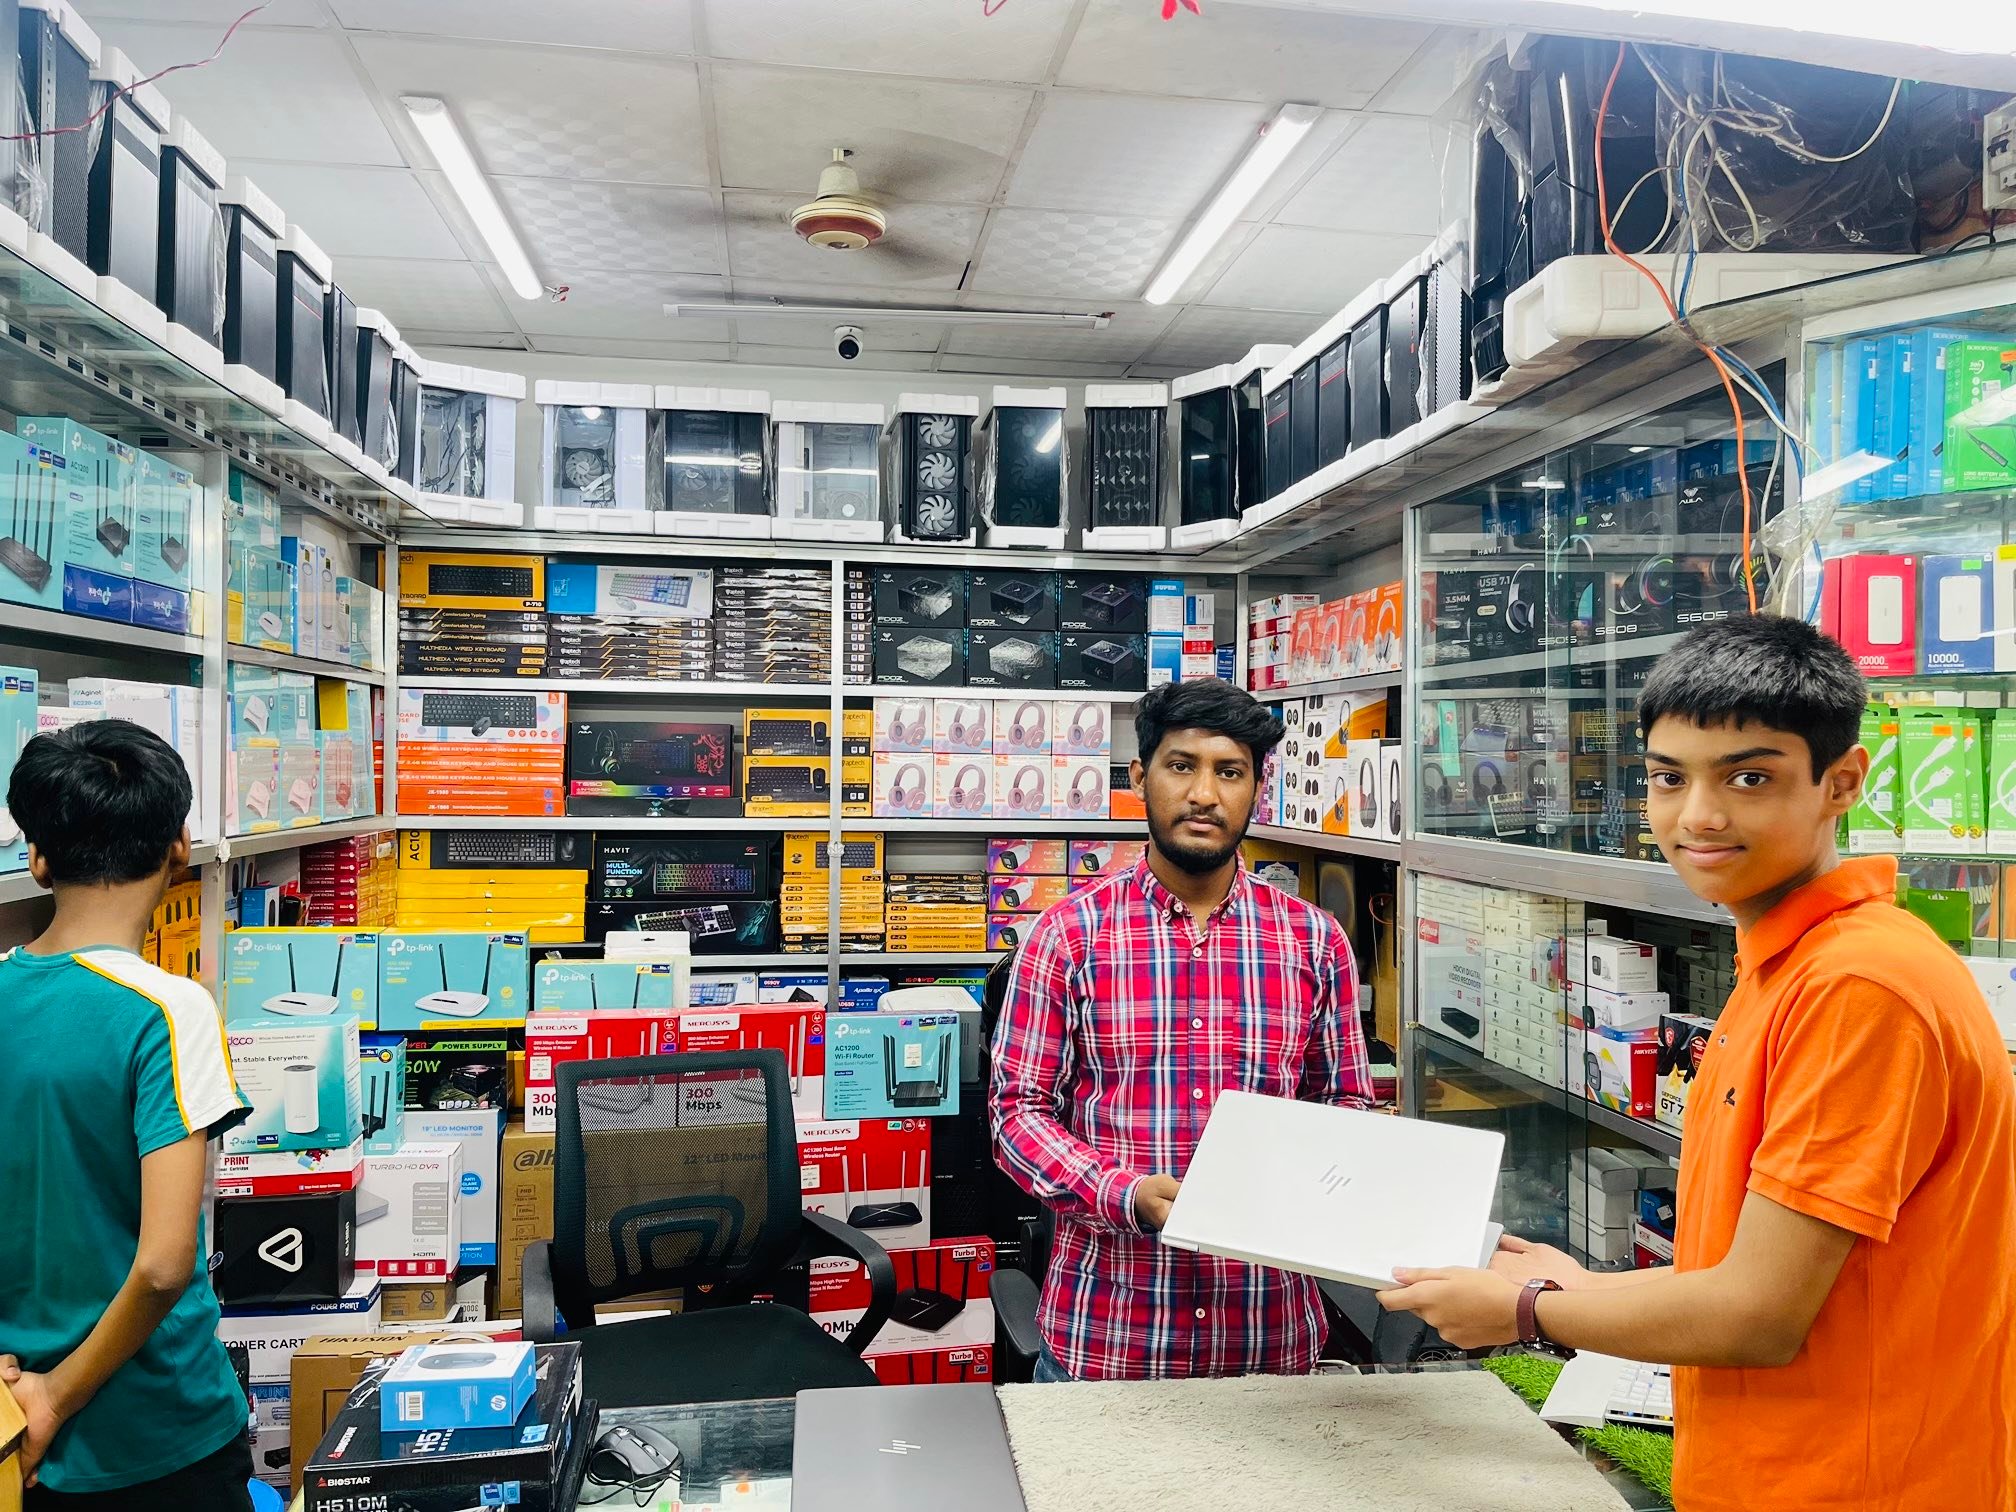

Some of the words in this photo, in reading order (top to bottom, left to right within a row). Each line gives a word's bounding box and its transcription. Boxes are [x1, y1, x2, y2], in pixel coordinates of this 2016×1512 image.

[1478, 546, 1502, 556] HAVIT
[1480, 578, 1498, 588] USB
[1500, 576, 1510, 586] 7.1
[1445, 595, 1470, 604] 3.5MM
[1595, 624, 1638, 636] S608
[1858, 656, 1884, 666] 20000
[1928, 654, 1959, 664] 10000
[254, 943, 282, 952] tp-link
[406, 943, 434, 953] tp-link
[560, 973, 586, 982] tp-link
[849, 1028, 871, 1036] tp-link
[834, 1044, 860, 1052] AC1200
[852, 1052, 874, 1060] Router
[686, 1088, 714, 1098] 300
[686, 1100, 722, 1112] Mbps
[1660, 1098, 1674, 1113] GT
[803, 1128, 851, 1136] MERCUSYS
[224, 1156, 250, 1166] PRINT
[954, 1249, 975, 1257] Turbo
[810, 1260, 850, 1270] ERCUSYS
[311, 1303, 338, 1311] POWER
[340, 1302, 360, 1311] PRINT
[223, 1340, 266, 1350] TONER
[270, 1338, 308, 1349] CART
[320, 1336, 410, 1344] HIKVISION
[950, 1352, 972, 1360] Turbo
[328, 1476, 371, 1487] BIOSTAR
[316, 1496, 387, 1512] H510M
